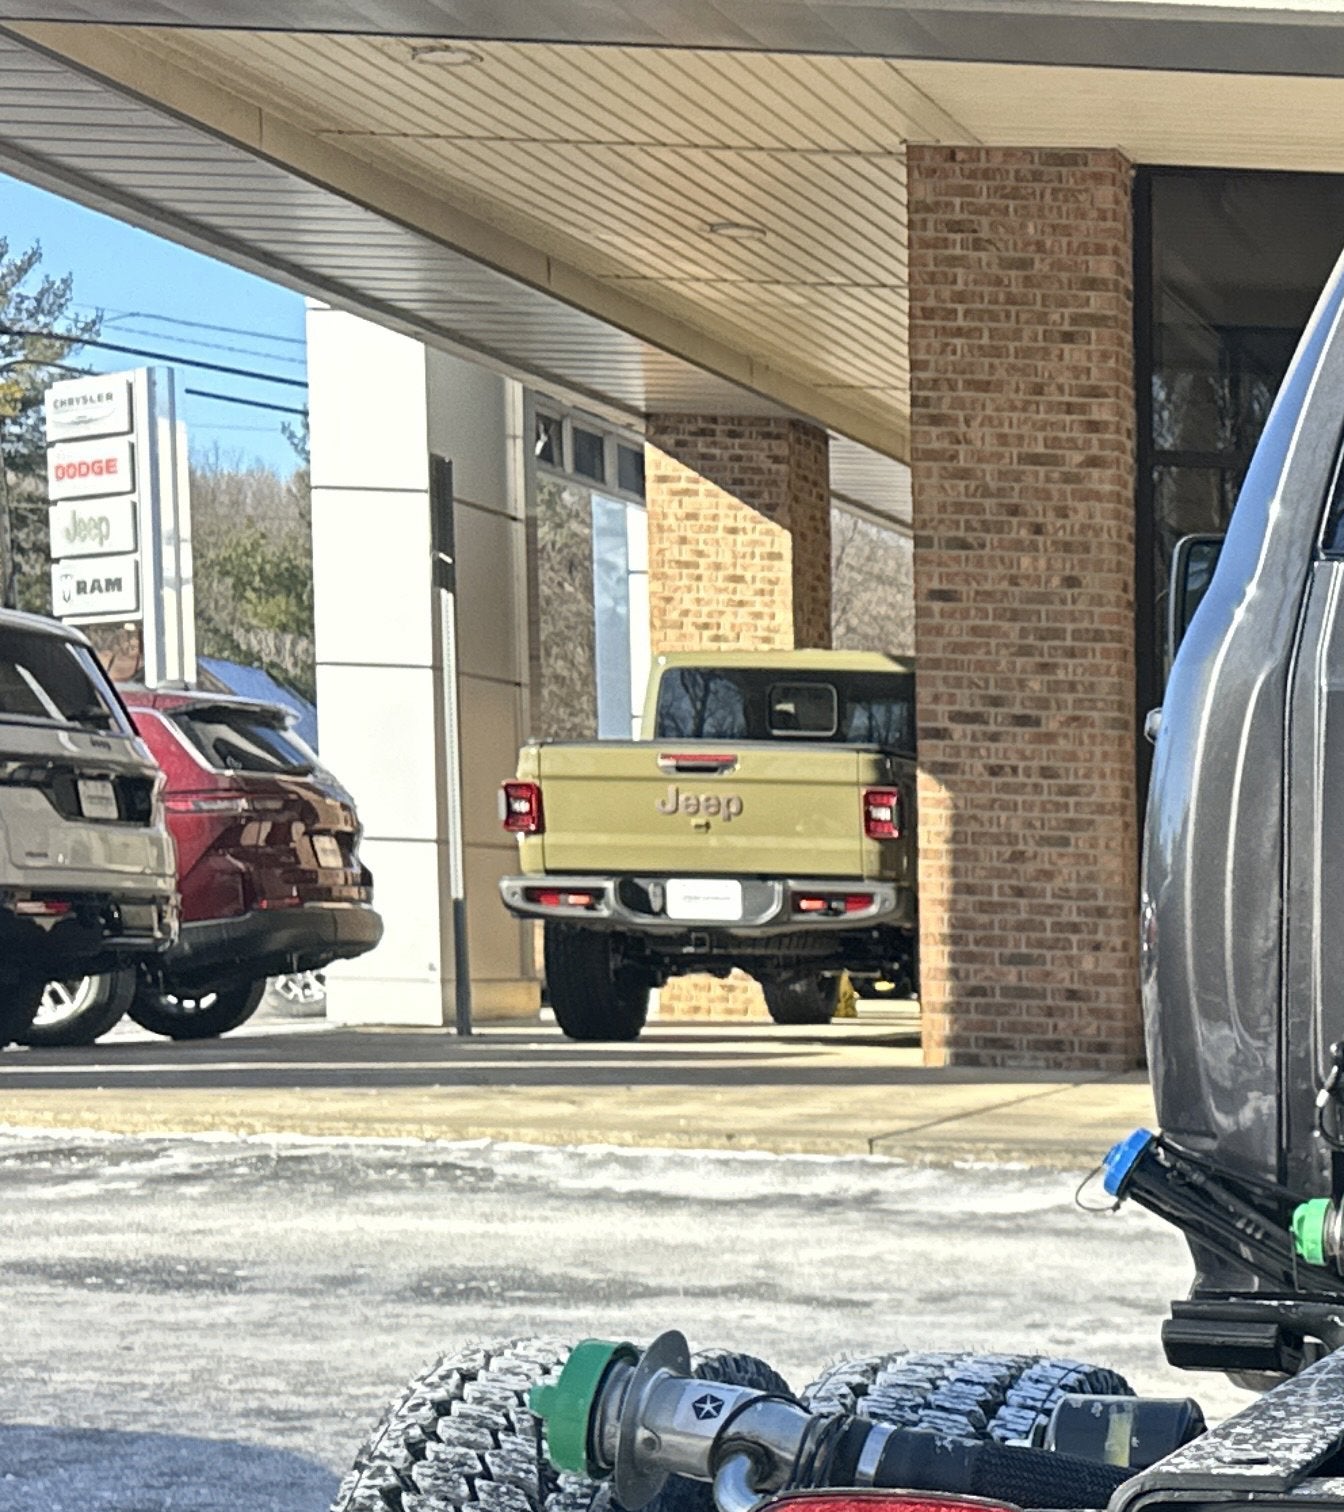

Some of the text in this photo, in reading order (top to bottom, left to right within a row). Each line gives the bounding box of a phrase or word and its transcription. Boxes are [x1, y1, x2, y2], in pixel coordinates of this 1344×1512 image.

[53, 392, 113, 410] CHRYSLER
[55, 458, 118, 481] DODGE
[65, 509, 110, 547] Jeep
[76, 577, 122, 595] RAM
[656, 784, 744, 822] Jeep
